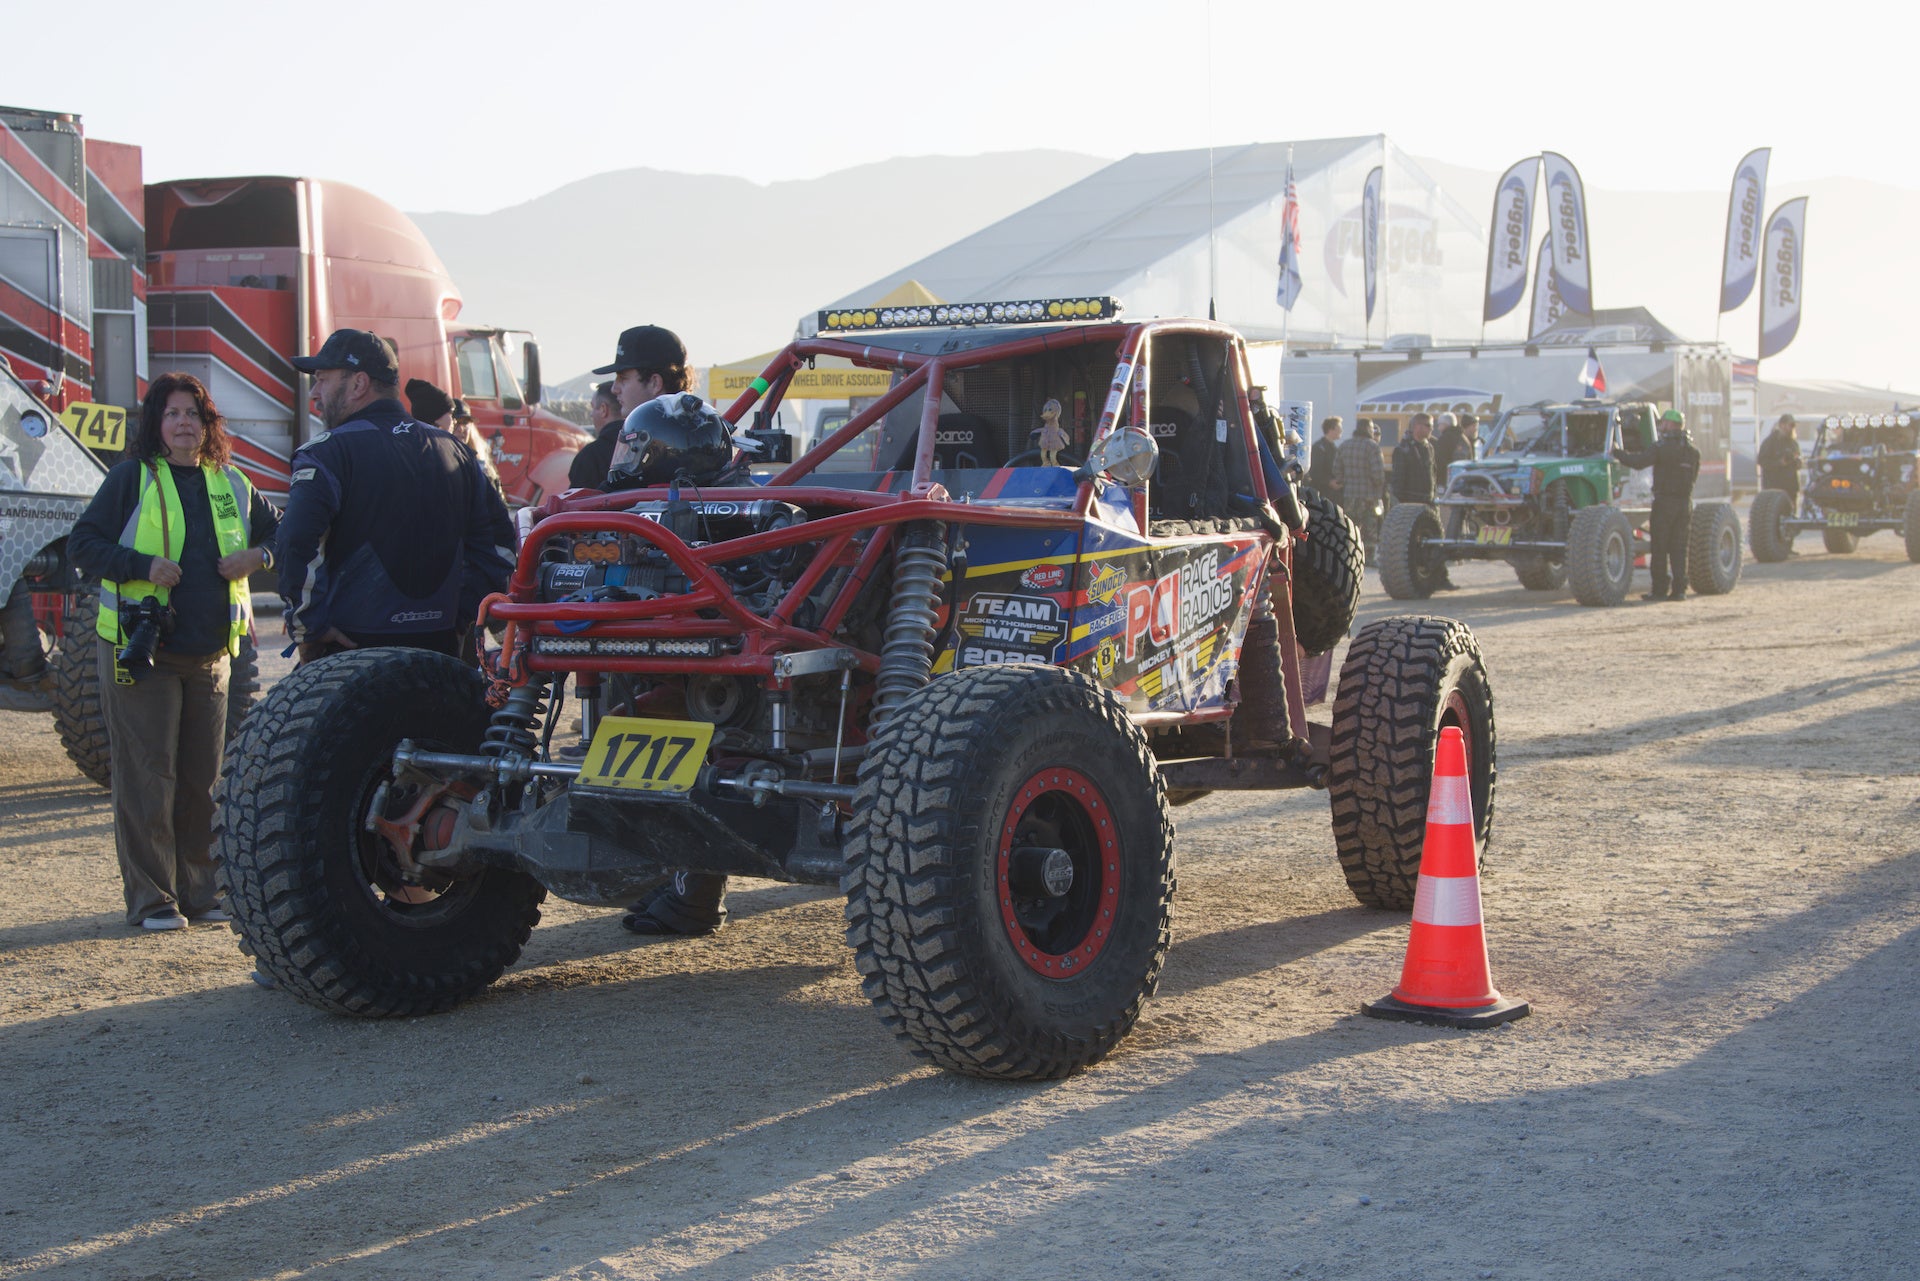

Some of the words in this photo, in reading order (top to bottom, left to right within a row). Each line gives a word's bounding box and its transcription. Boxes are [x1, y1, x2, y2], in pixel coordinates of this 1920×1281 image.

[1507, 186, 1526, 269] rugged.
[1559, 180, 1581, 264] rugged.
[1740, 177, 1759, 261] rugged.
[1776, 227, 1795, 307] rugged.
[794, 374, 819, 386] WHEEL
[821, 374, 844, 386] DRIVE
[71, 407, 125, 446] 747
[556, 569, 585, 577] PRO
[1034, 573, 1046, 581] RED
[1047, 570, 1062, 579] LINE
[1090, 571, 1125, 600] SUNOCO
[1182, 549, 1218, 601] RACE
[975, 598, 1051, 621] TEAM
[1125, 569, 1181, 664] PCI
[1182, 572, 1233, 635] RADIOS
[963, 617, 998, 625] MICKEY
[999, 619, 1059, 632] THOMPSON
[983, 626, 1037, 643] M/T
[1089, 618, 1108, 635] RACE
[1102, 646, 1111, 666] 8
[1137, 648, 1171, 674] MICKEY
[1172, 621, 1214, 655] THOMPSON
[598, 733, 696, 781] 1717
